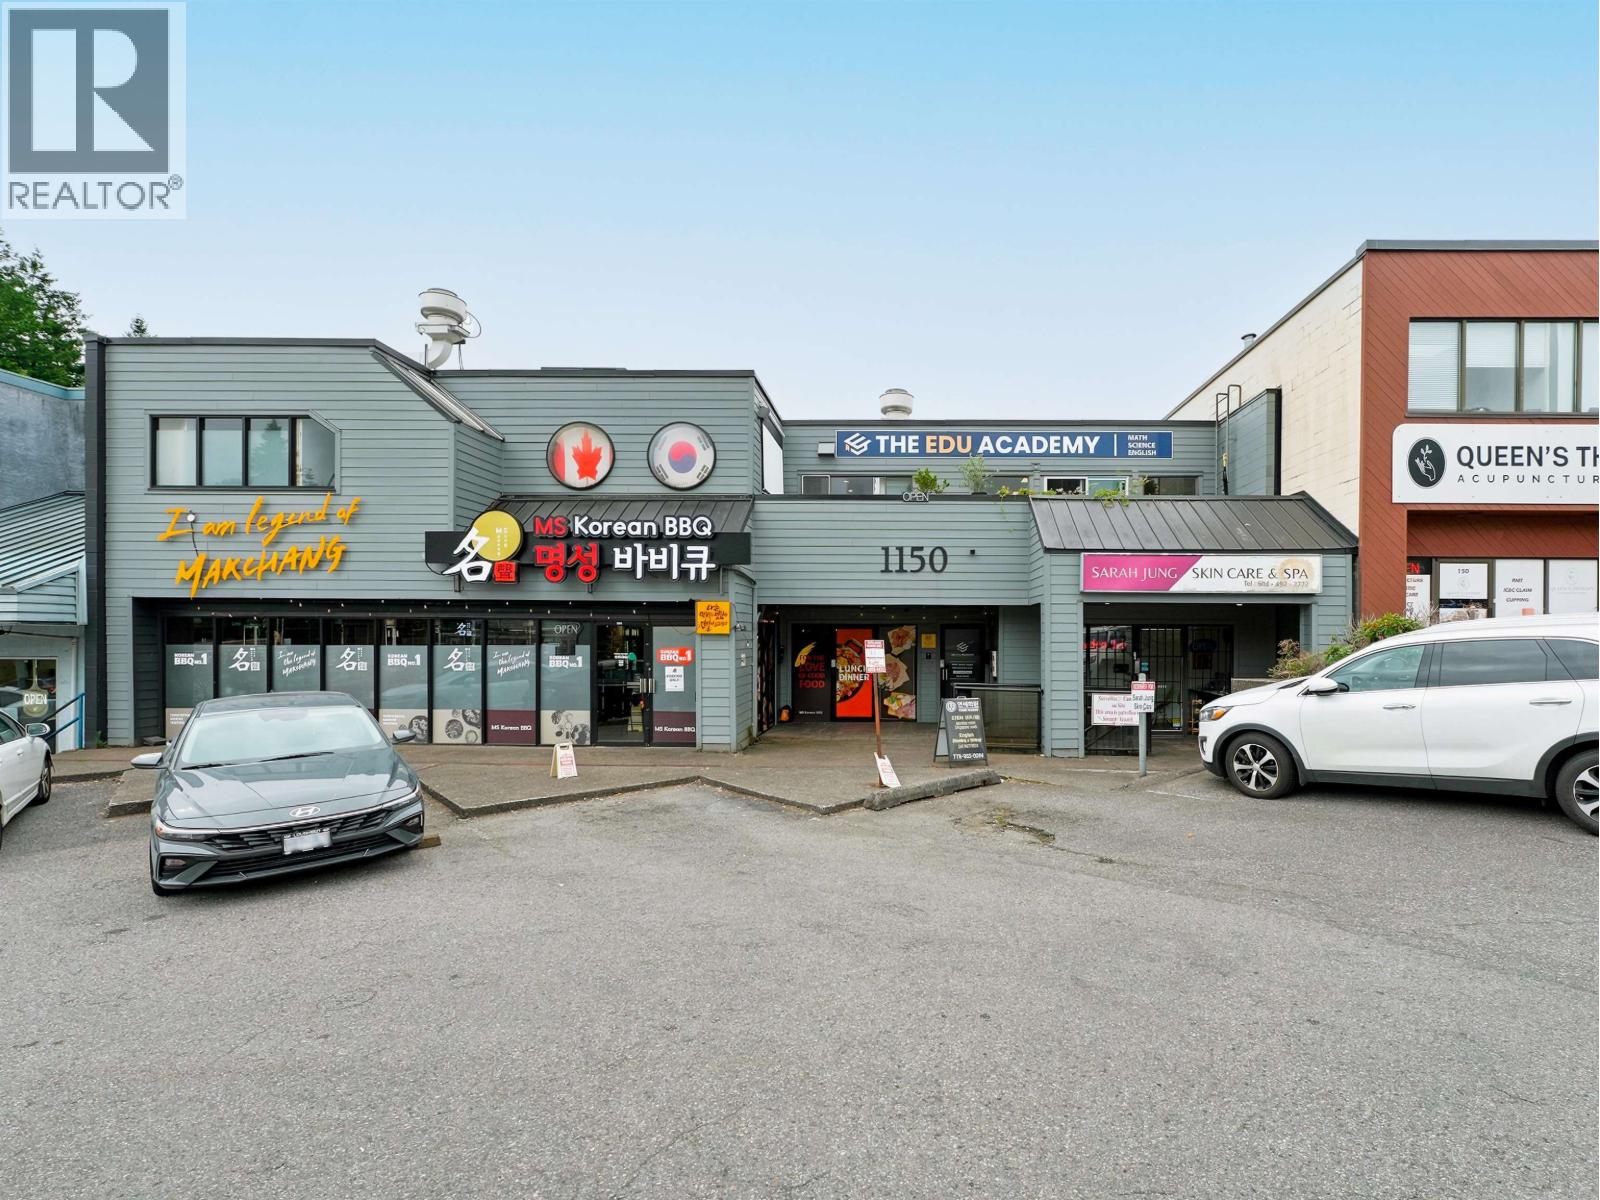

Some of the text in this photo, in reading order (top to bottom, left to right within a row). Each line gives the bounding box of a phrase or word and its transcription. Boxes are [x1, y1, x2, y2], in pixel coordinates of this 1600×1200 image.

[875, 435, 1100, 454] THE EDU ACADEMY
[1456, 445, 1569, 470] QUEEN'S
[902, 491, 930, 502] OPEN
[157, 493, 362, 548] I am legend of
[533, 515, 713, 537] MS Korean BBQ
[534, 542, 600, 584] 명성
[612, 542, 717, 582] 바비큐
[880, 546, 949, 574] 1150
[175, 535, 348, 600] MAKCHANG
[1091, 566, 1309, 582] SARAH JUNG SKIN CARE & SPA
[554, 624, 578, 635] OPEN
[174, 657, 195, 666] BBQ
[201, 653, 207, 665] 1
[387, 658, 408, 667] BBQ
[414, 654, 421, 665] 1
[549, 660, 570, 669] BBQ
[576, 656, 583, 667] 1
[800, 680, 825, 688] FOOD
[839, 673, 870, 681] DINNER
[24, 694, 47, 705] OPEN
